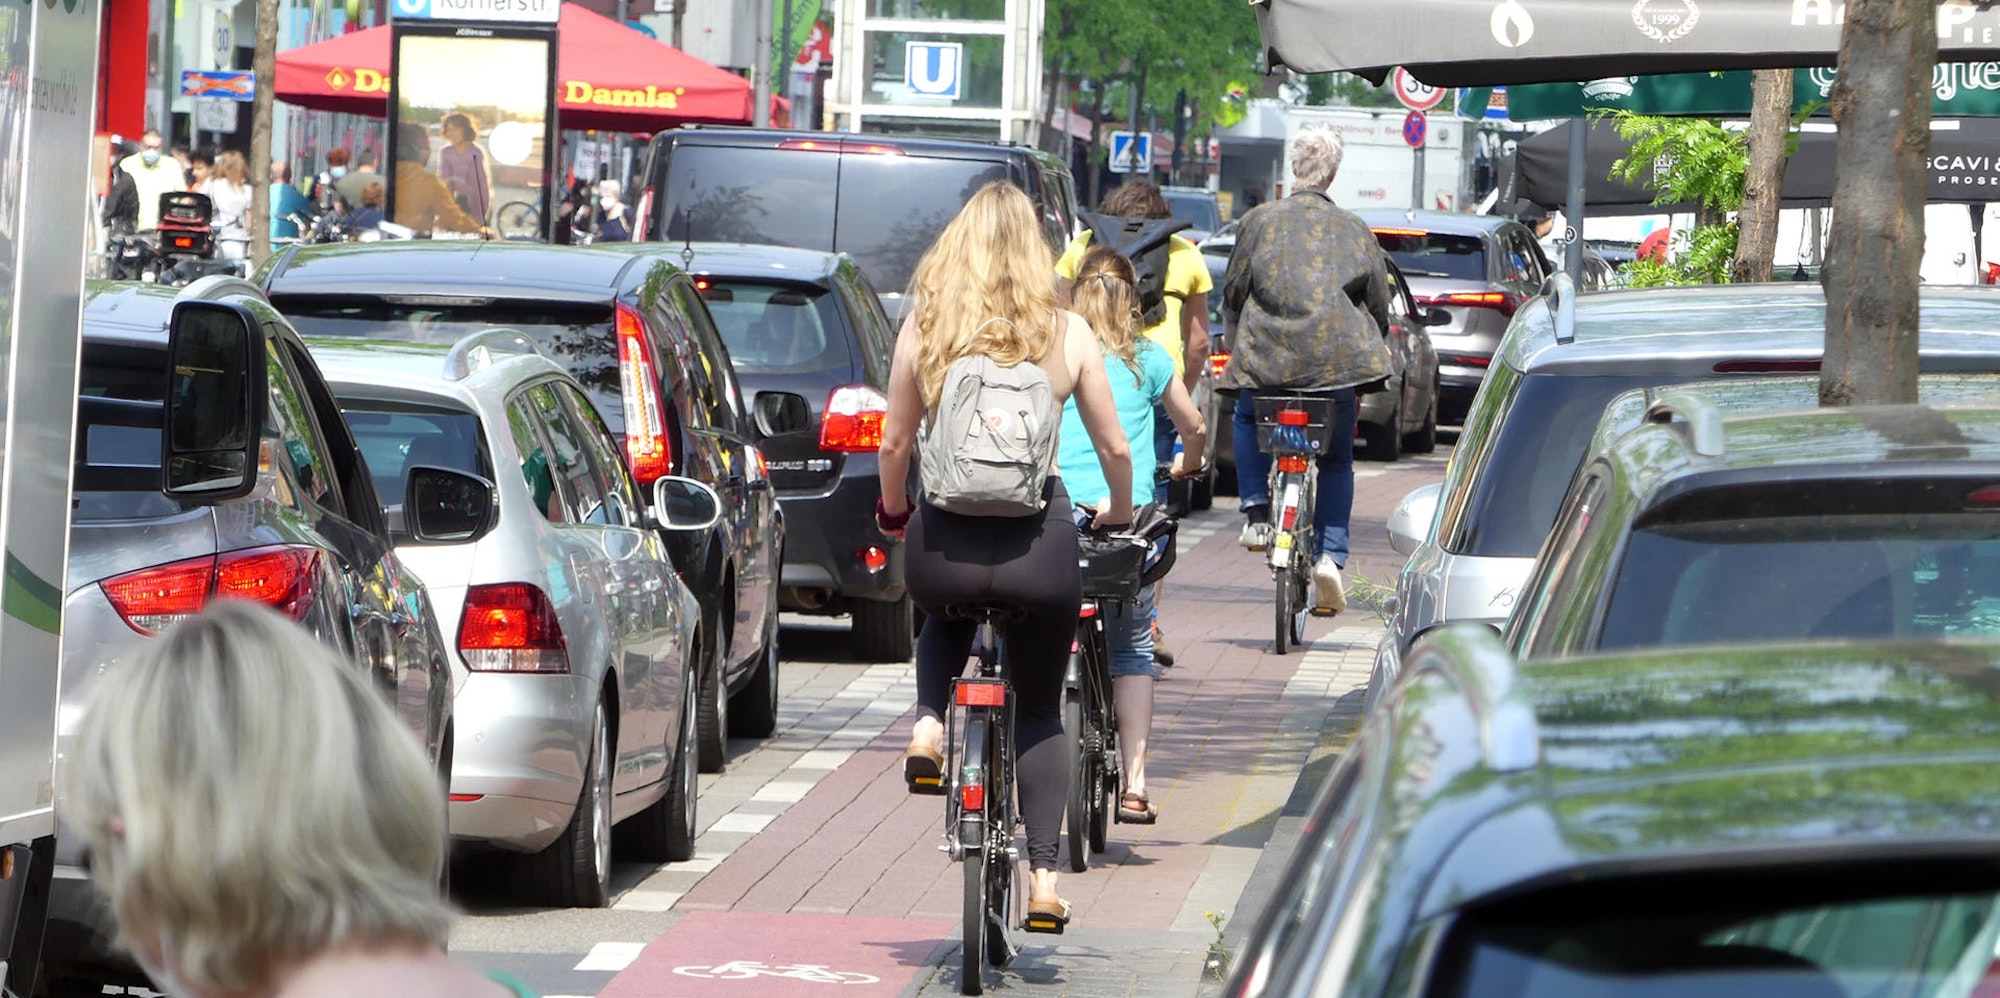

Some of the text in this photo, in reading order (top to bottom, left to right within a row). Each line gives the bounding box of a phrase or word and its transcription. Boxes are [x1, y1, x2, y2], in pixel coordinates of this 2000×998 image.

[1652, 14, 1680, 25] 1999
[911, 46, 956, 93] U
[564, 81, 678, 109] Damla
